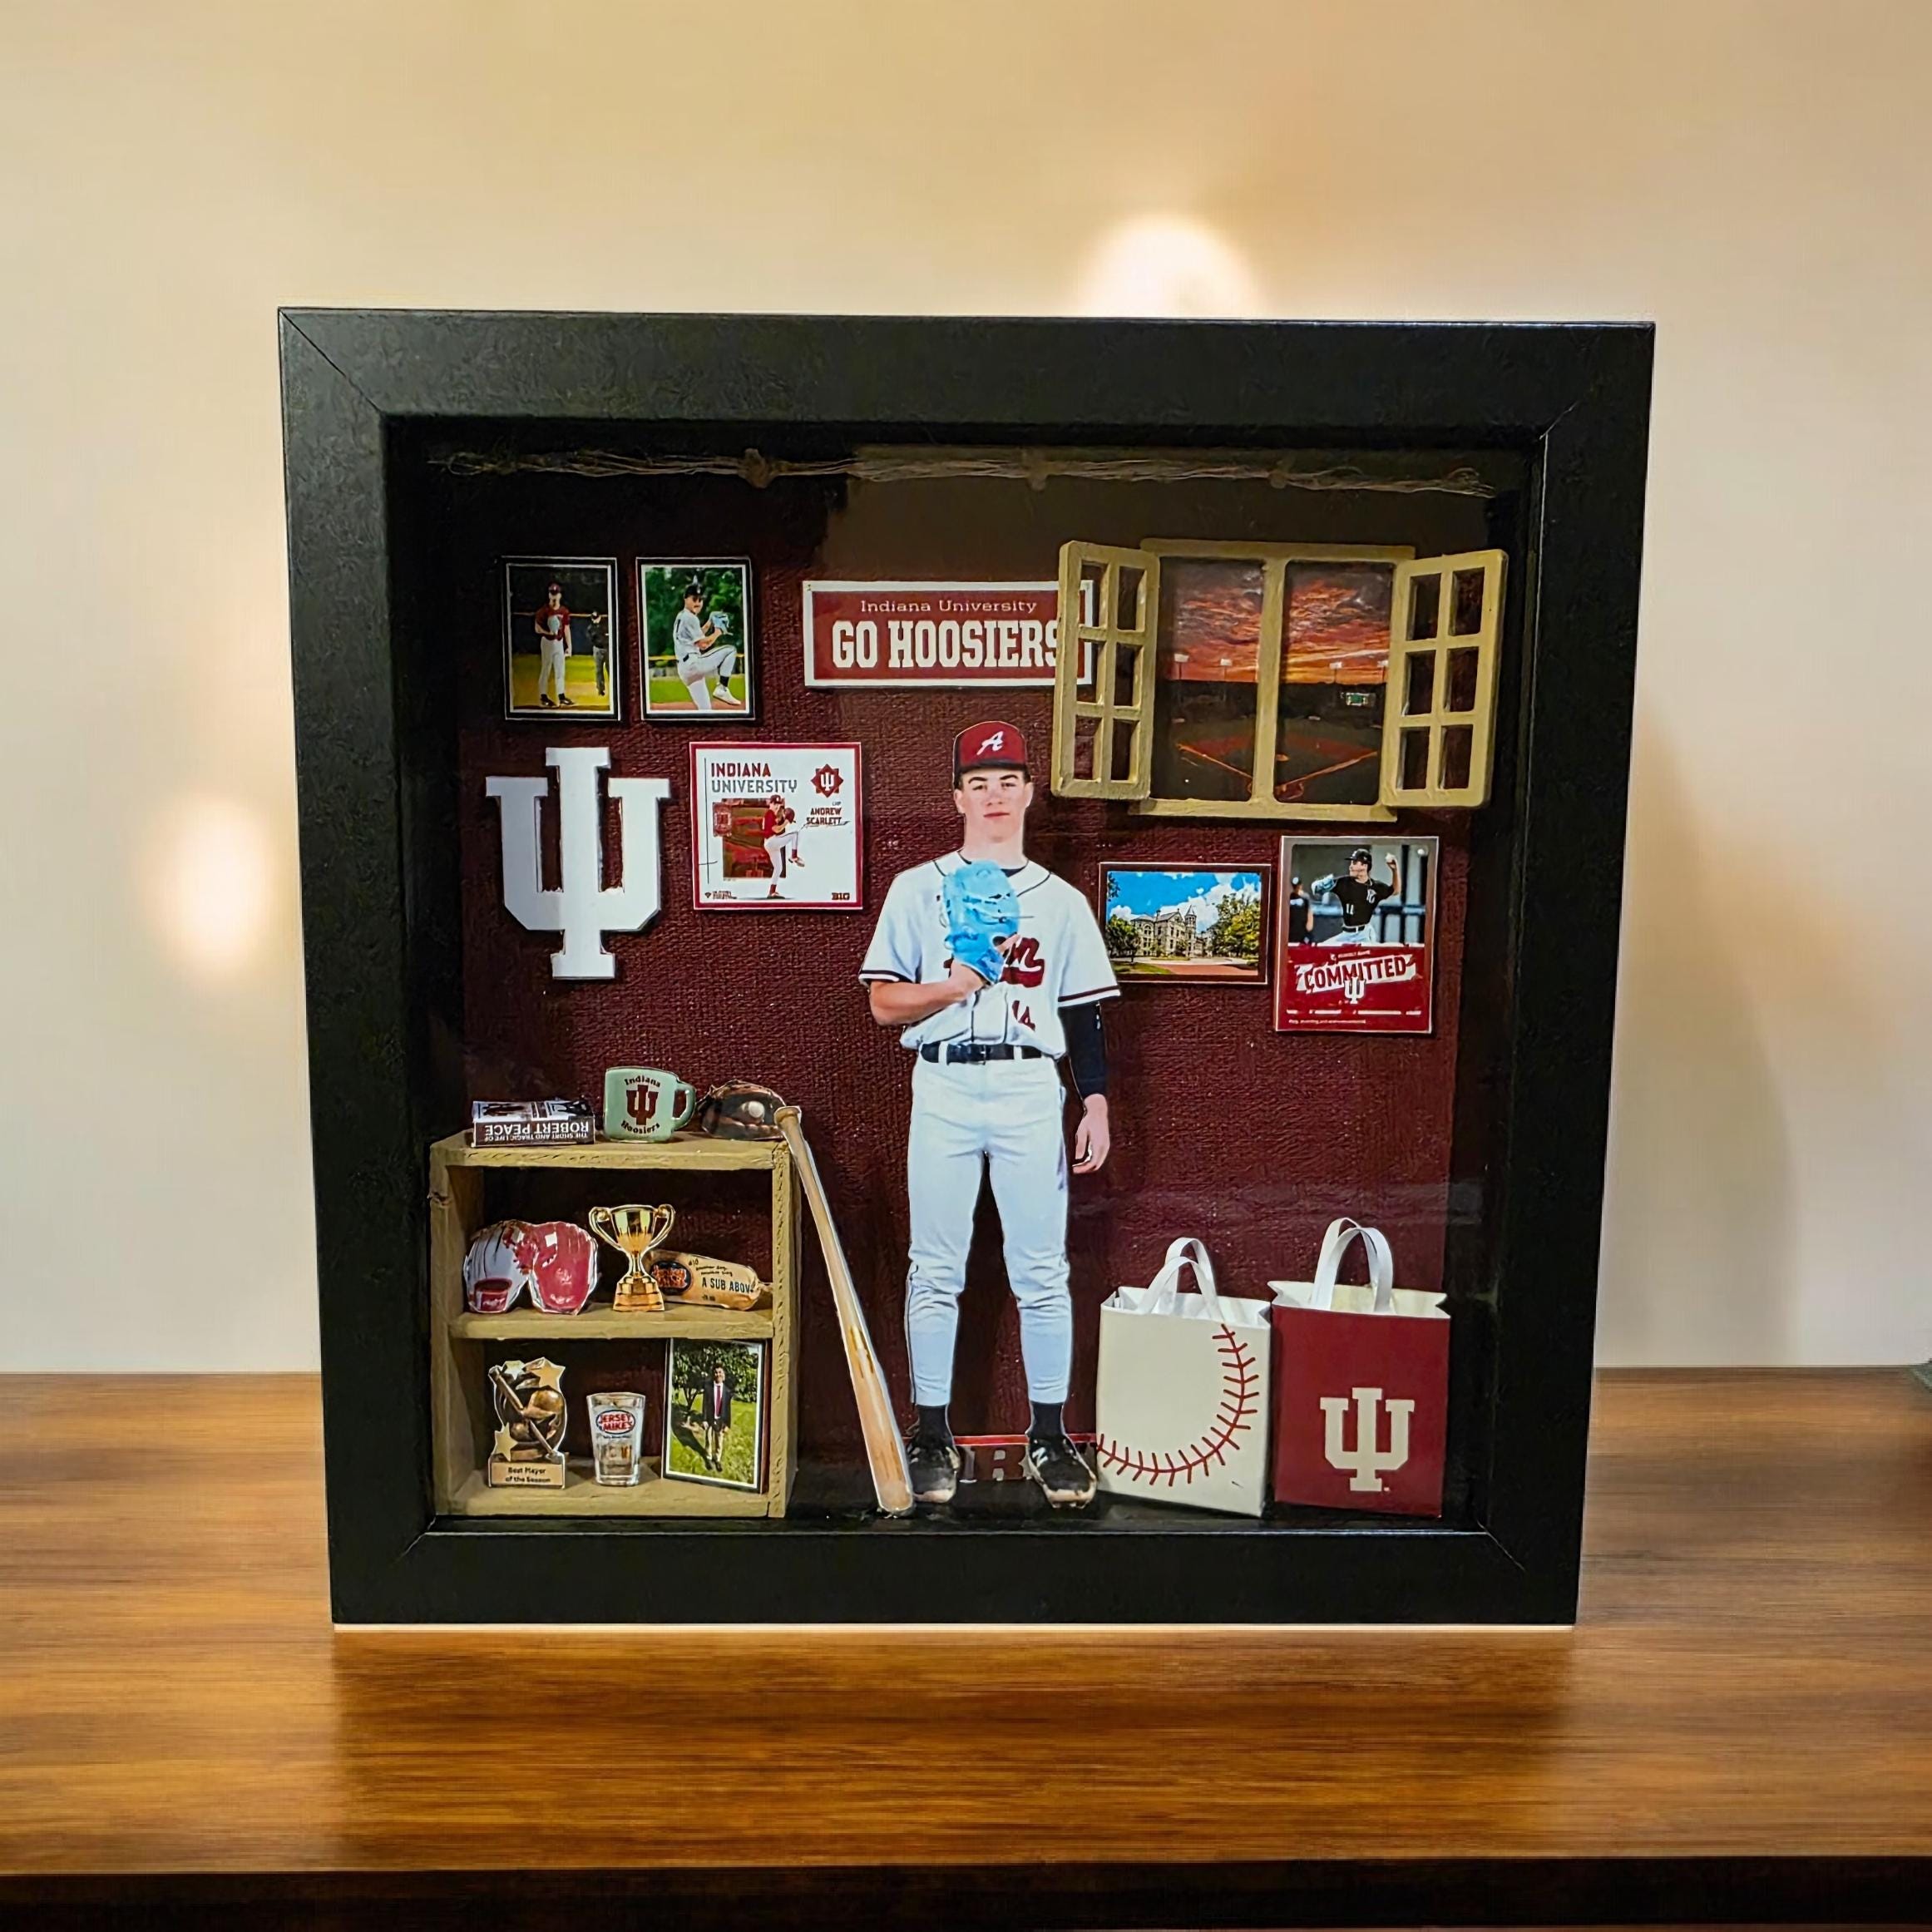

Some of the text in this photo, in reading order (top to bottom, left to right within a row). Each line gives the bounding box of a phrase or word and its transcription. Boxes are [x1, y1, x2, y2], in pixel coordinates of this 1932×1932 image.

[861, 600, 1037, 614] Indiana University
[833, 620, 878, 669] GO
[976, 731, 1004, 755] A
[711, 762, 772, 778] INDIANA
[712, 779, 798, 793] UNIVERSITY
[811, 807, 842, 815] ANDREW
[806, 817, 842, 825] SCARLETT
[1303, 956, 1407, 991] COMMITTED
[625, 1075, 660, 1088] Indiana
[485, 1121, 589, 1136] ROBERT PEACE
[621, 1119, 660, 1134] Hoosiers
[702, 1277, 754, 1294] A SUB ABOV
[599, 1414, 631, 1423] JERSEY
